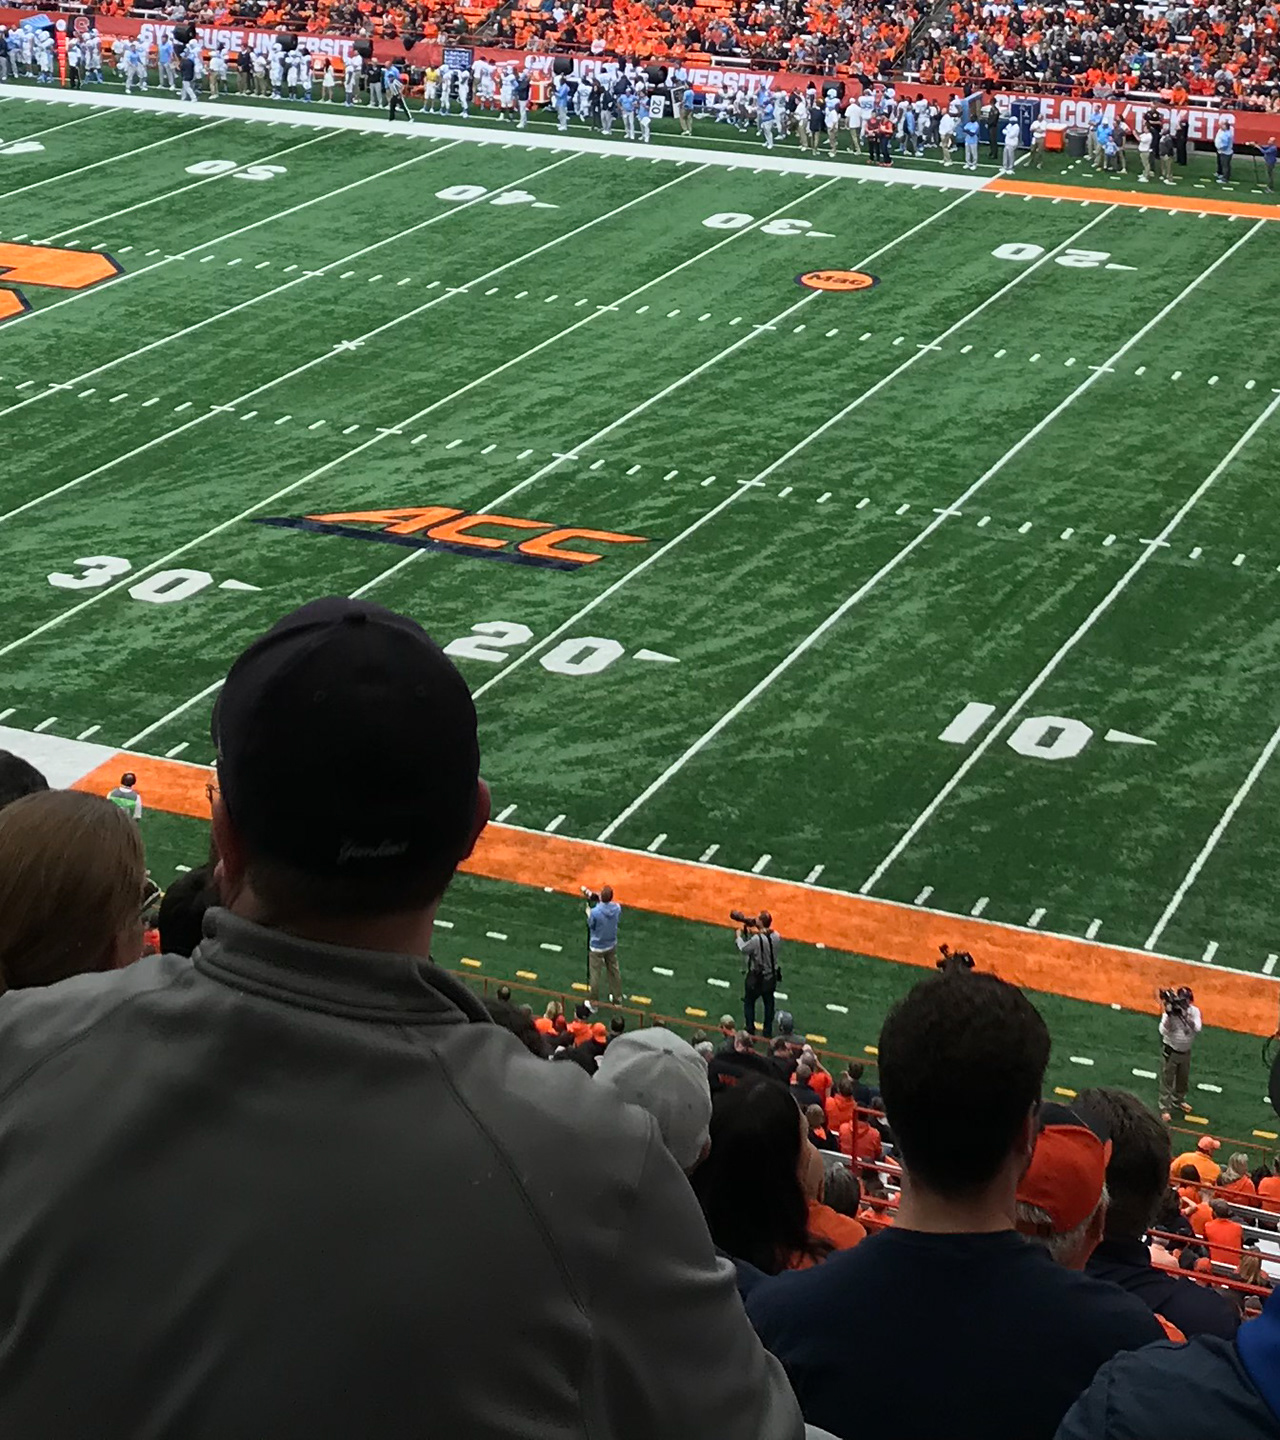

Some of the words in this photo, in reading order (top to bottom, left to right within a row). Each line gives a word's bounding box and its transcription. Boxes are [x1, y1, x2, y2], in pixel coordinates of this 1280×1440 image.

[185, 159, 289, 180] 50
[434, 184, 537, 206] 40
[701, 212, 813, 236] 30
[990, 242, 1112, 269] 20
[807, 270, 867, 291] Mac
[298, 504, 655, 565] ACC
[46, 554, 214, 604] 30
[442, 620, 626, 676] 20
[937, 700, 1094, 761] 10
